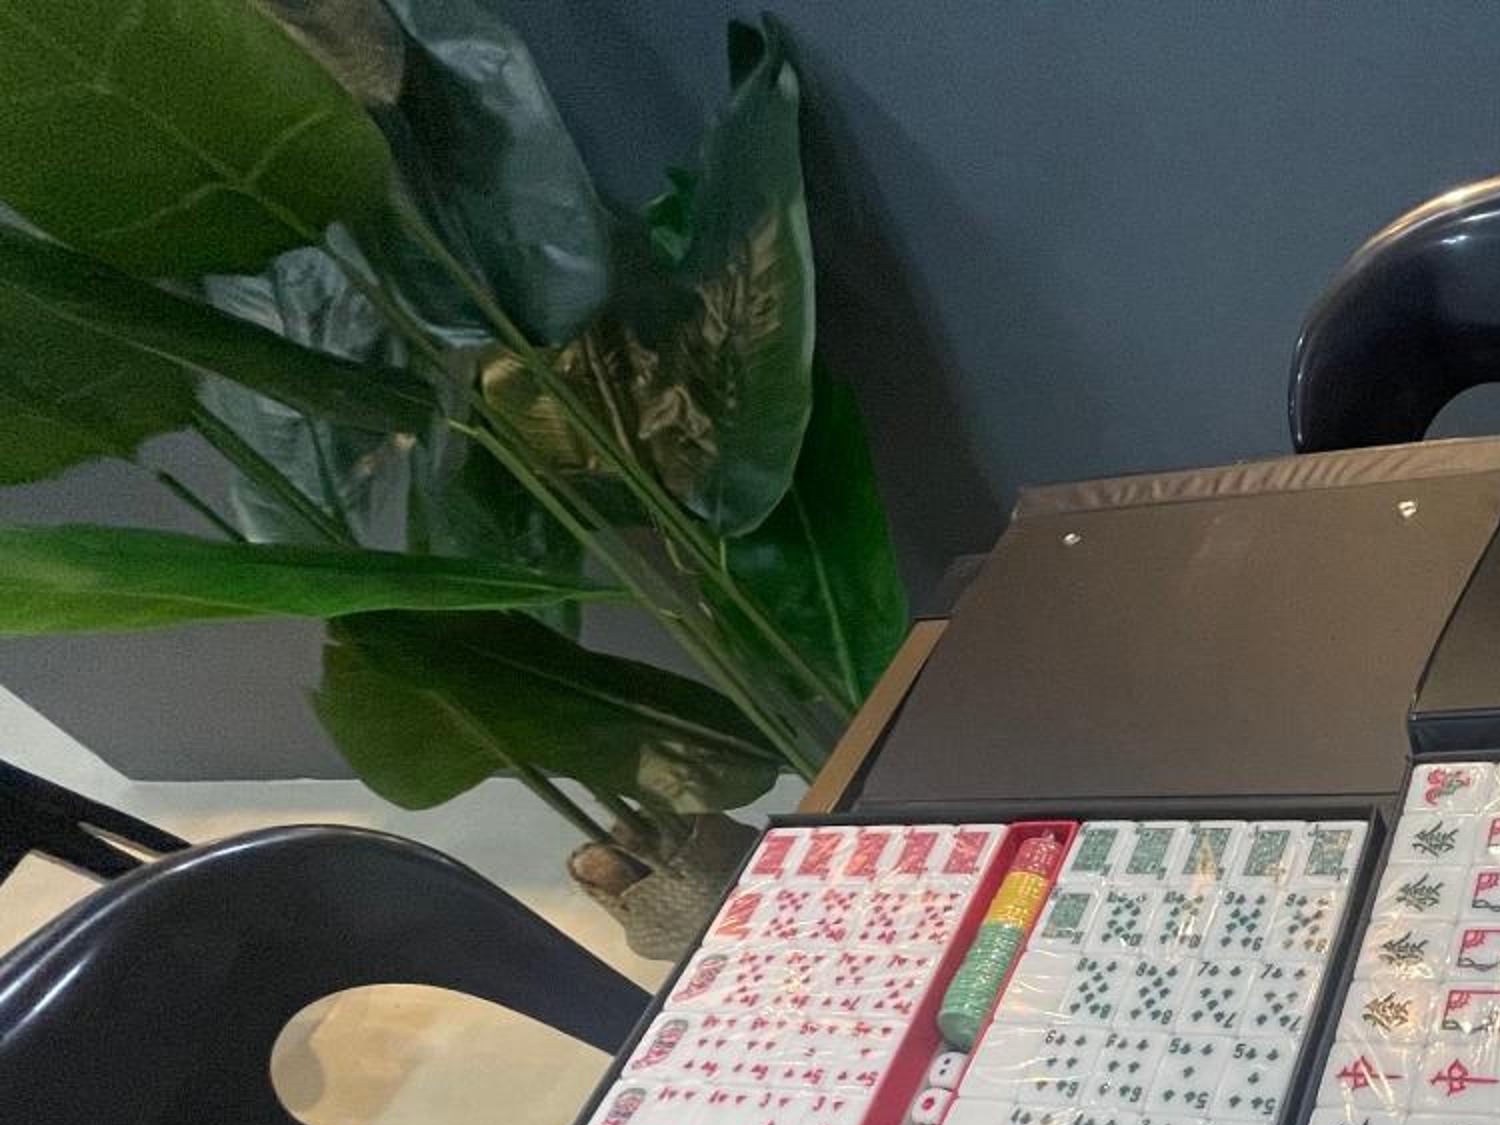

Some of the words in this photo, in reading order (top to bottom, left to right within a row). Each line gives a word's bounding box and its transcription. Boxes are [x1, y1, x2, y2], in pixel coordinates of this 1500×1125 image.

[1411, 820, 1459, 858] 發
[1395, 873, 1444, 912] 發
[1168, 1038, 1182, 1053] 5
[1233, 1043, 1247, 1058] 5
[1335, 1055, 1402, 1091] 中
[1430, 1058, 1500, 1097] 中
